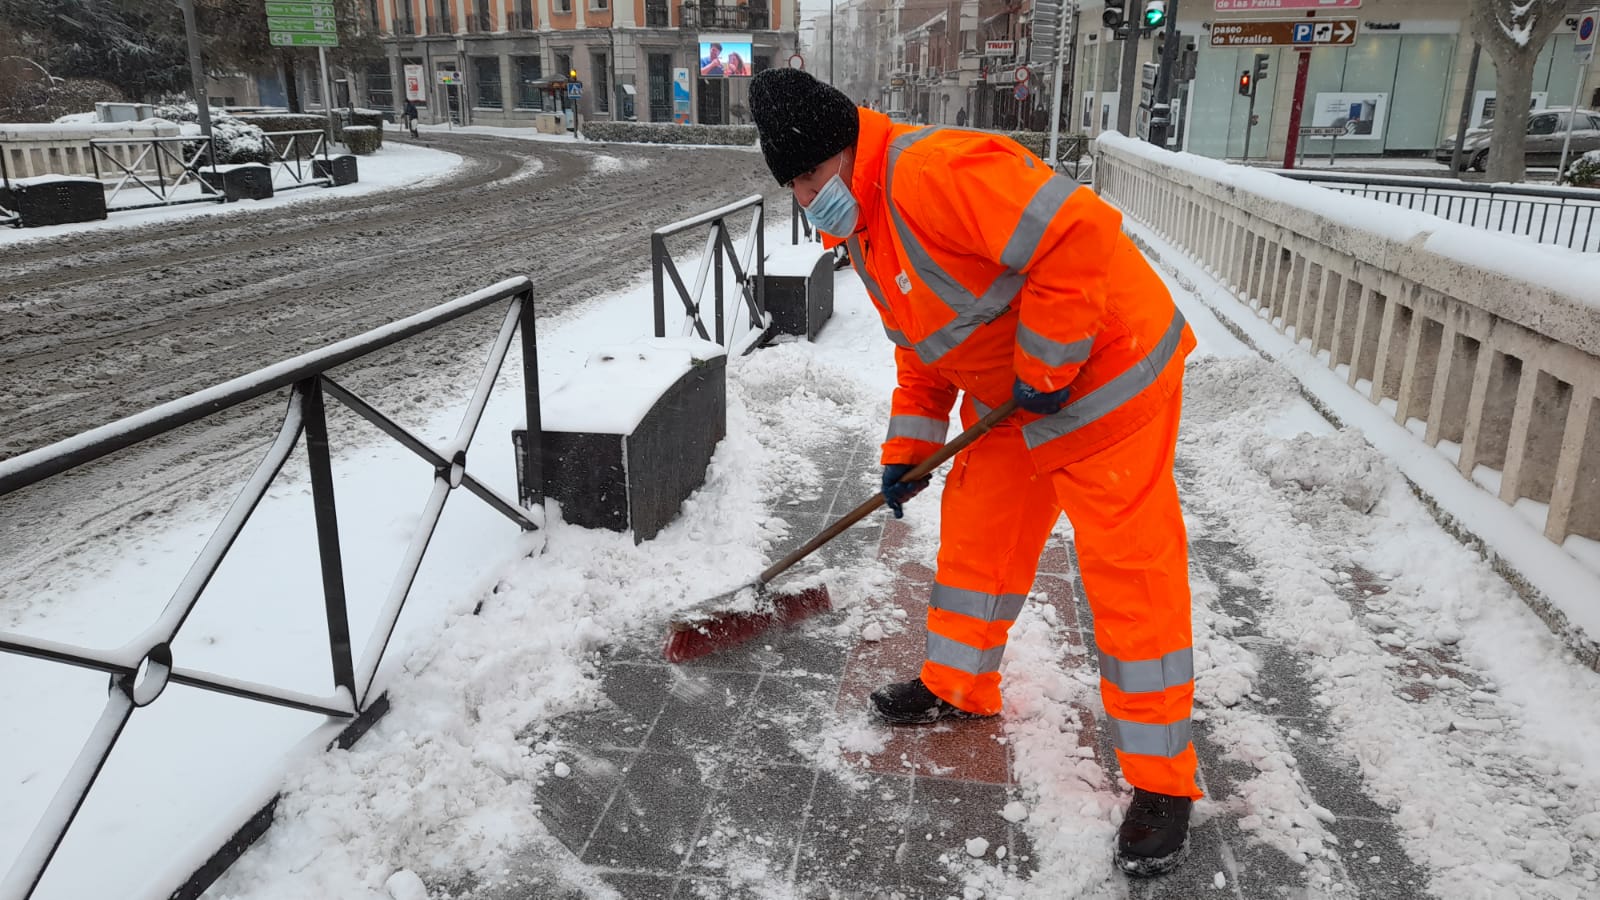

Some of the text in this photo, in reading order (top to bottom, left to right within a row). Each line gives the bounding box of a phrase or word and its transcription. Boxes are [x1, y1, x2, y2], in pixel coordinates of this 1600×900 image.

[1217, 0, 1229, 8] de
[1233, 0, 1248, 8] las
[1214, 25, 1242, 35] paseo
[1296, 25, 1311, 41] P
[1212, 34, 1273, 44] de Versalles
